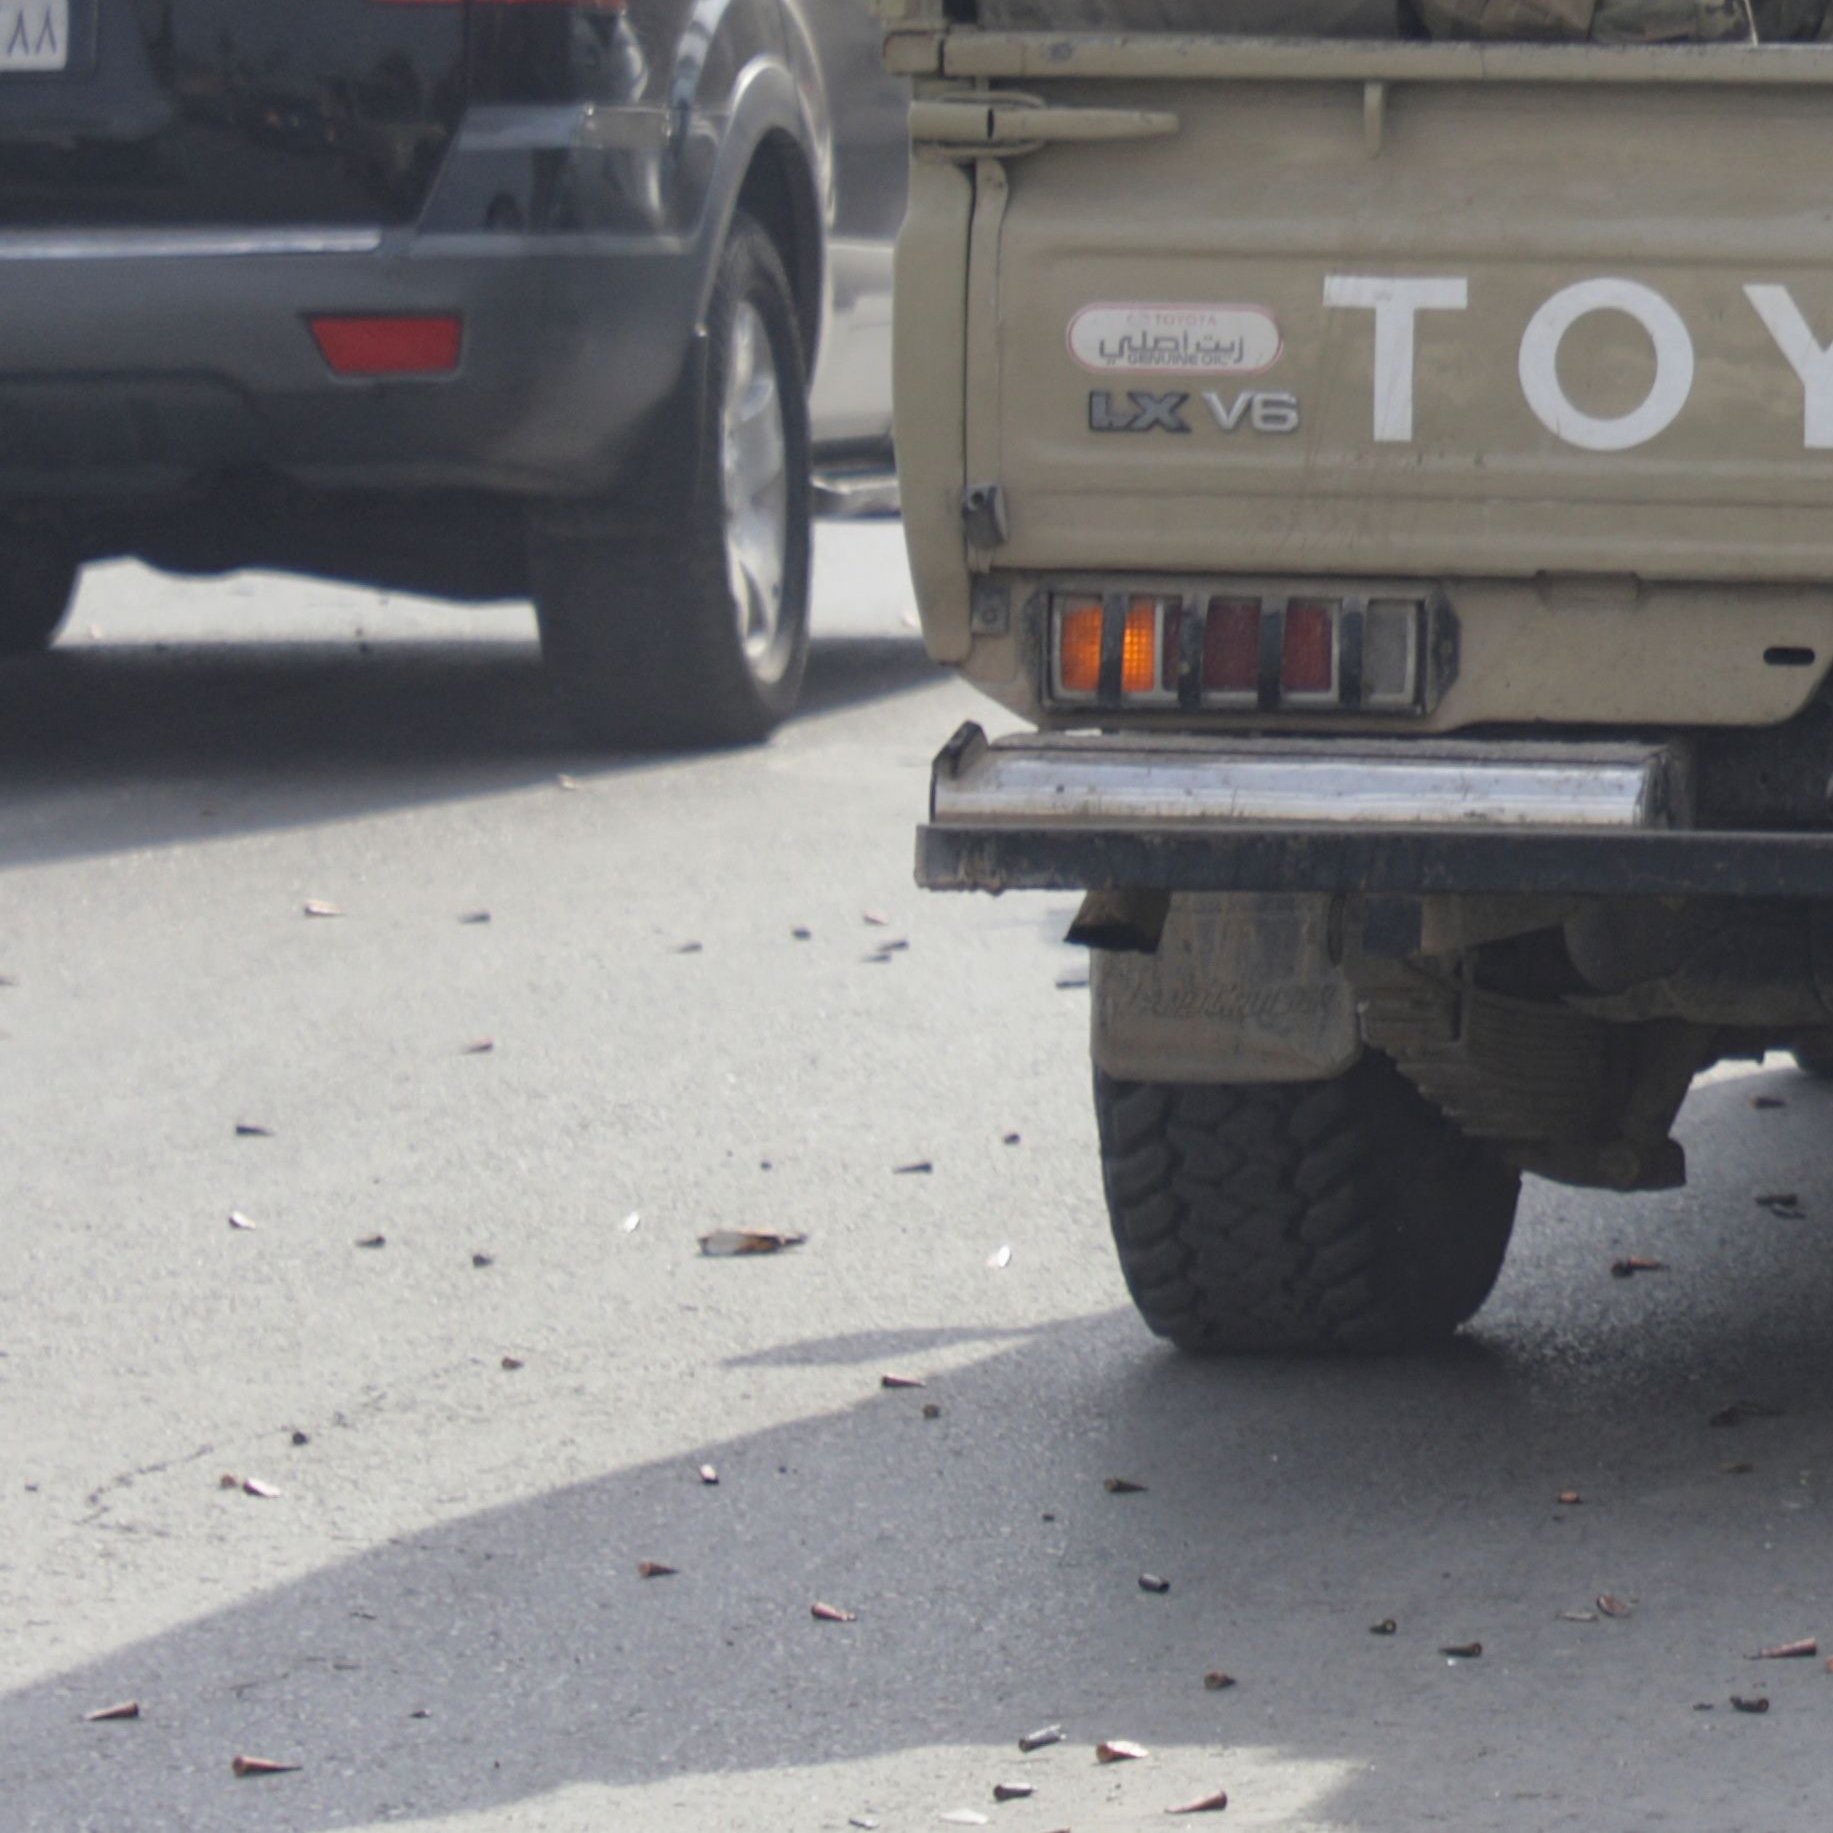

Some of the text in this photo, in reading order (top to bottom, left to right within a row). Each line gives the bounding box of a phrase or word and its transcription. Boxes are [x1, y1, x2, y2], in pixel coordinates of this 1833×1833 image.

[1155, 315, 1217, 327] TOYOTA
[1127, 354, 1229, 367] GENUINE OIL
[1089, 389, 1300, 434] LX V6
